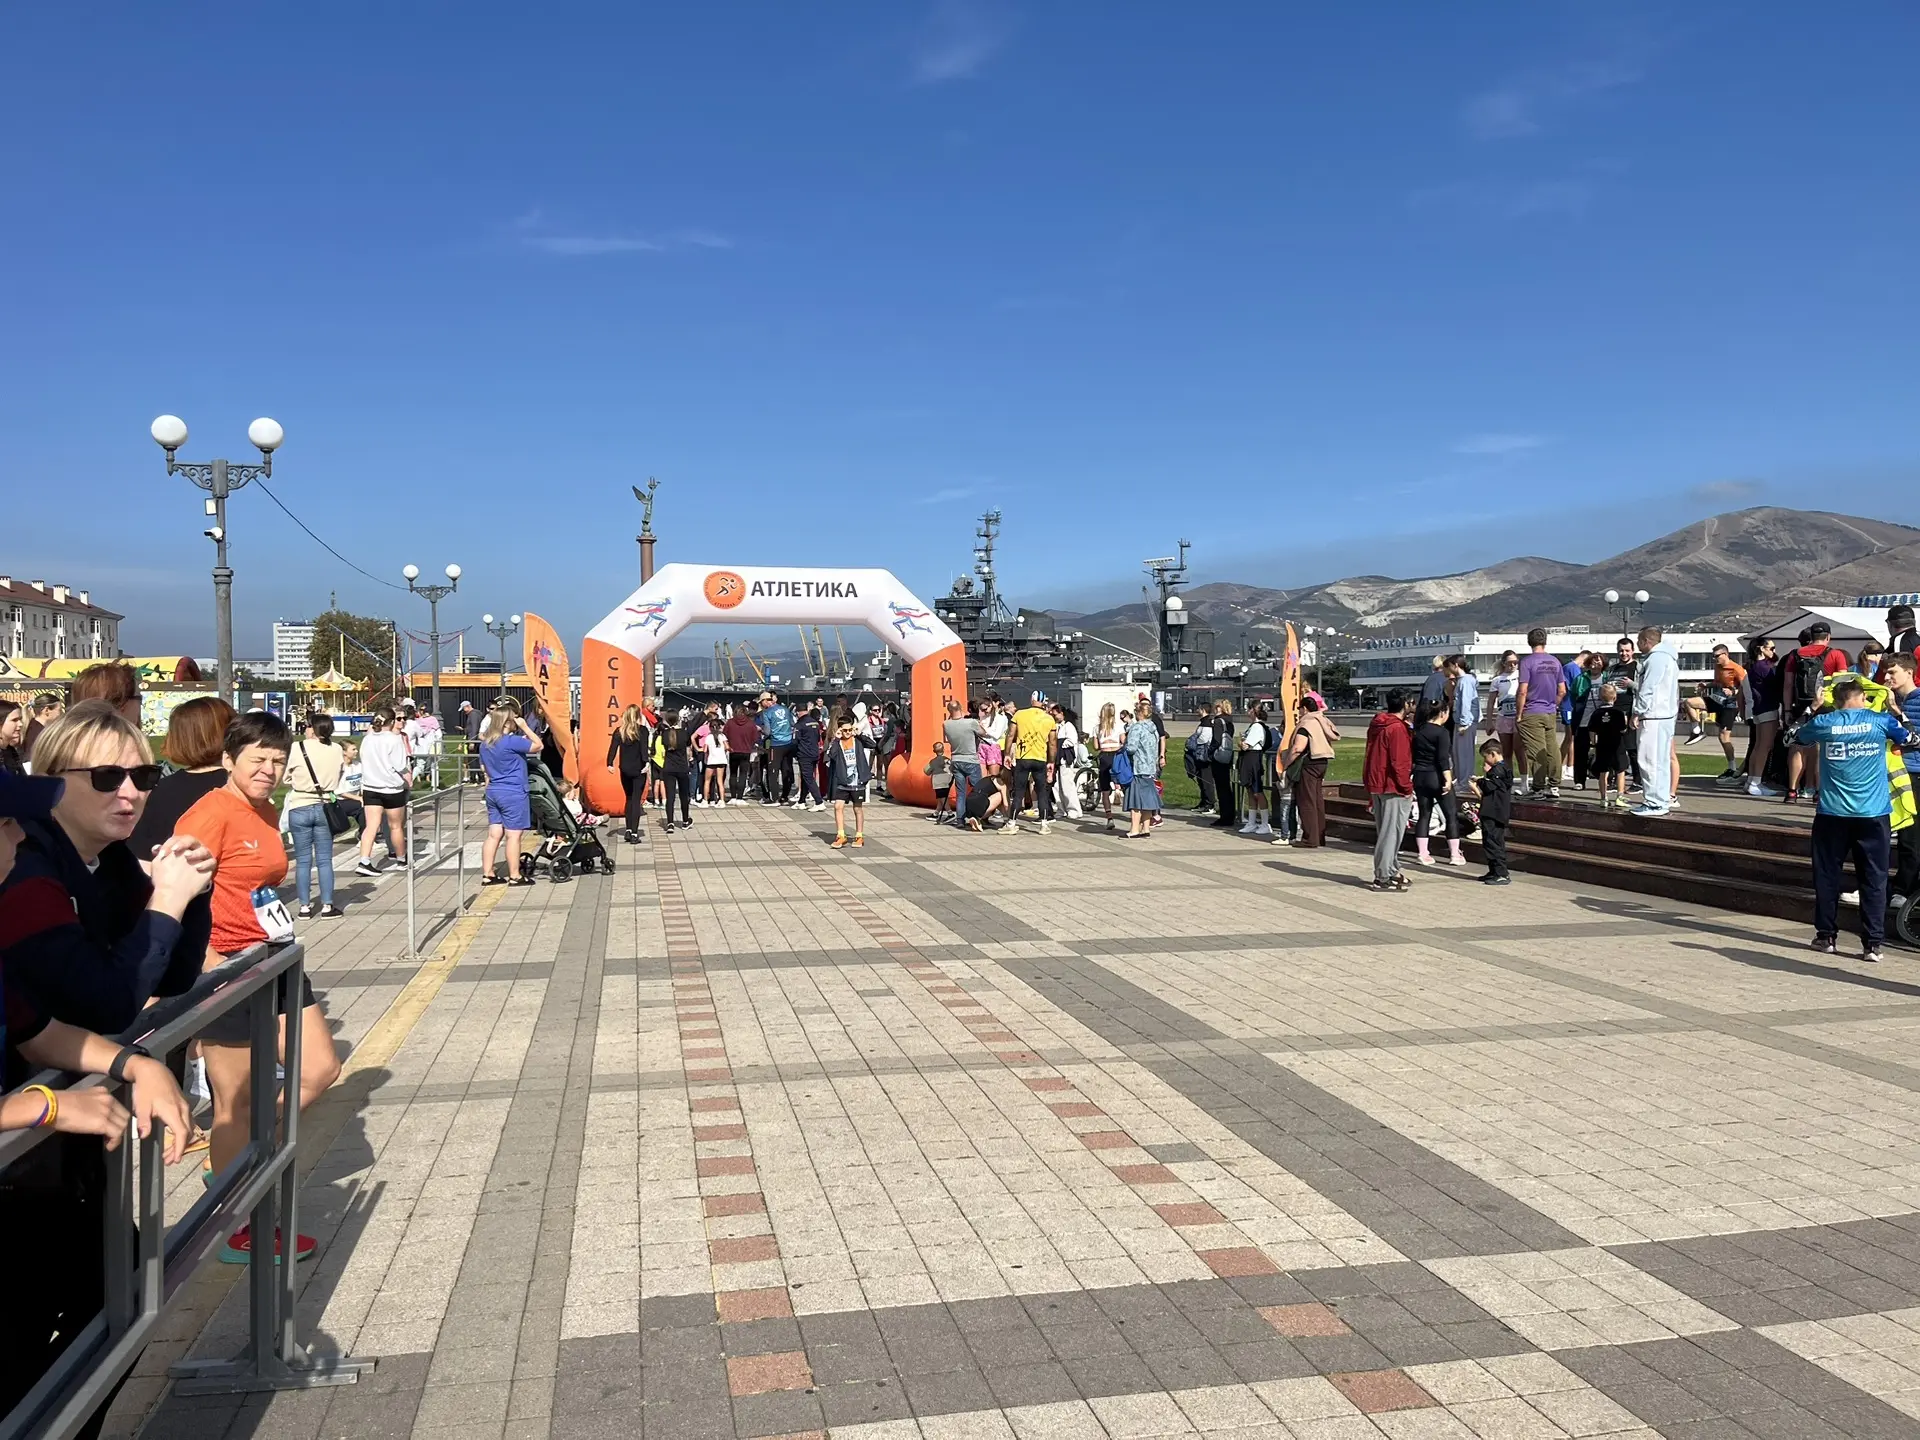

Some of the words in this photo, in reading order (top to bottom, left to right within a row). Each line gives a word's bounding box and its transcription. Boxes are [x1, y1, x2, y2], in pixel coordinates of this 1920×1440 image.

[750, 580, 858, 598] АТЛЕТИКА
[939, 659, 953, 744] ФИН
[1847, 742, 1879, 750] Кубань
[1848, 749, 1881, 758] Кредит
[267, 903, 294, 927] 11
